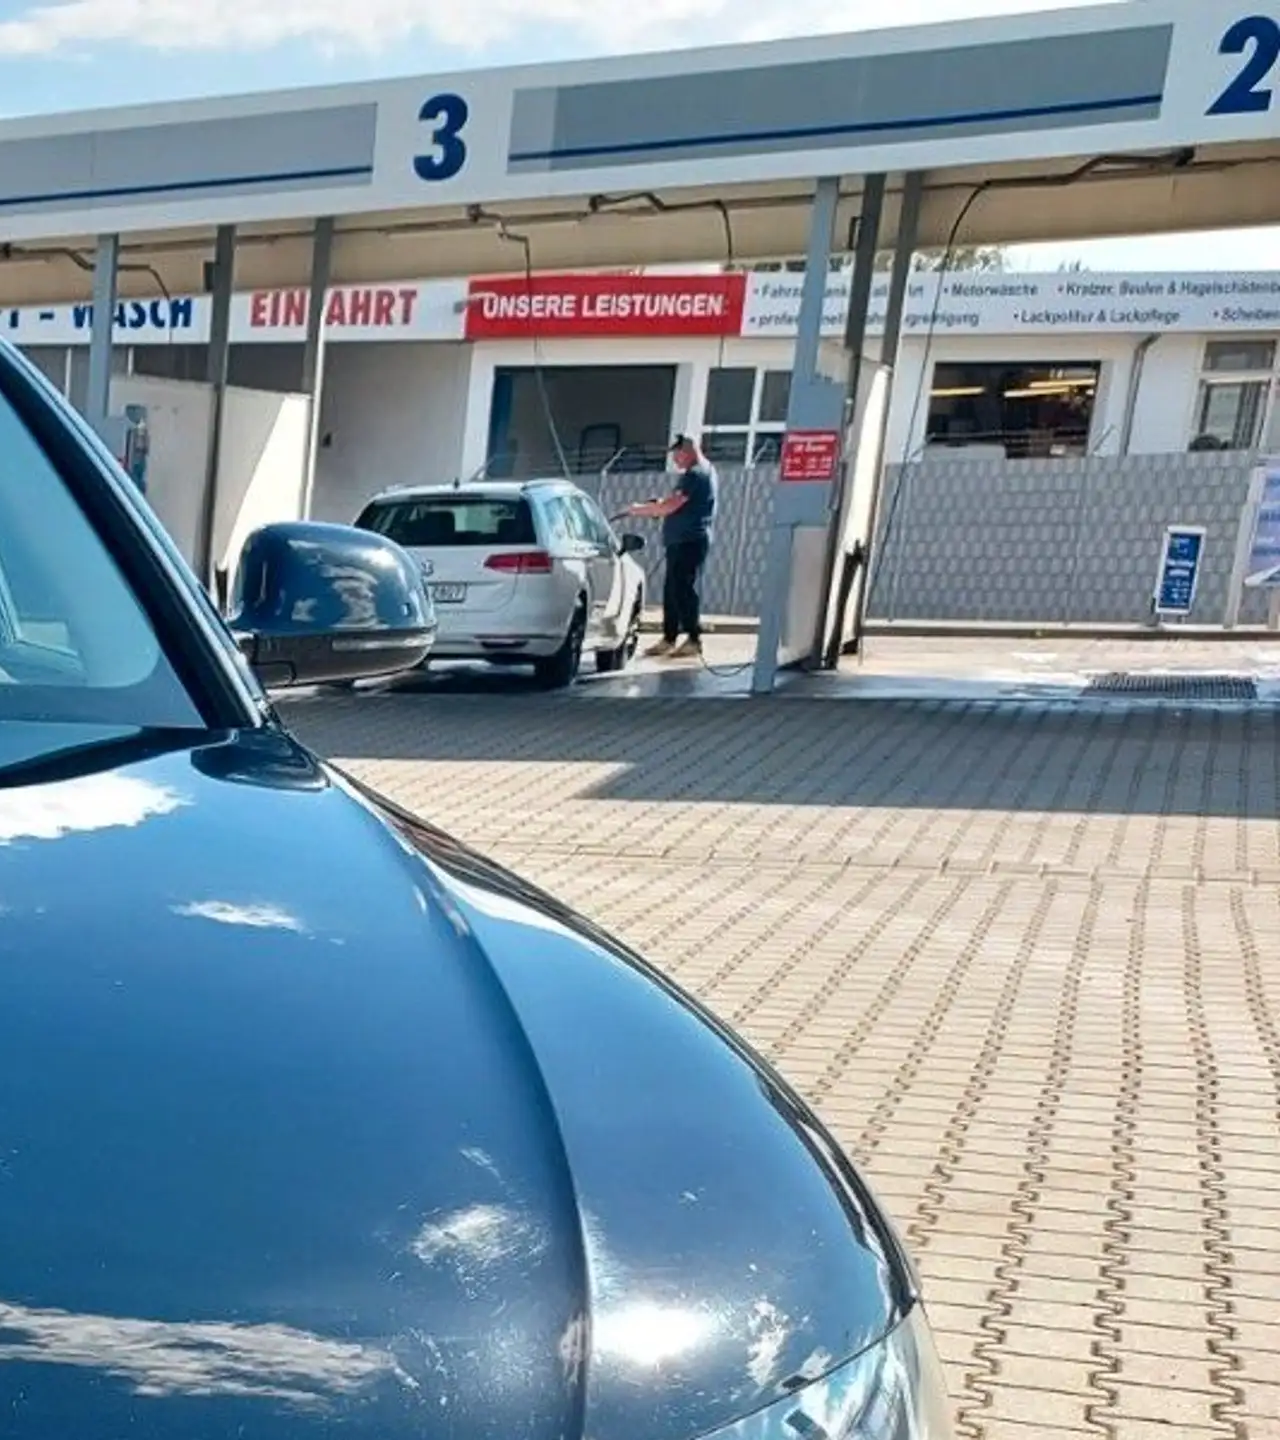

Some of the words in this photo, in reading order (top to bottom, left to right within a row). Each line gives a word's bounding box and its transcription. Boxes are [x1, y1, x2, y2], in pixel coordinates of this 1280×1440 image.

[1204, 14, 1280, 116] 2
[412, 93, 469, 181] 3
[251, 288, 417, 327] EINAHRT
[482, 293, 576, 319] UNSERE
[582, 293, 723, 318] LEISTUNGEN
